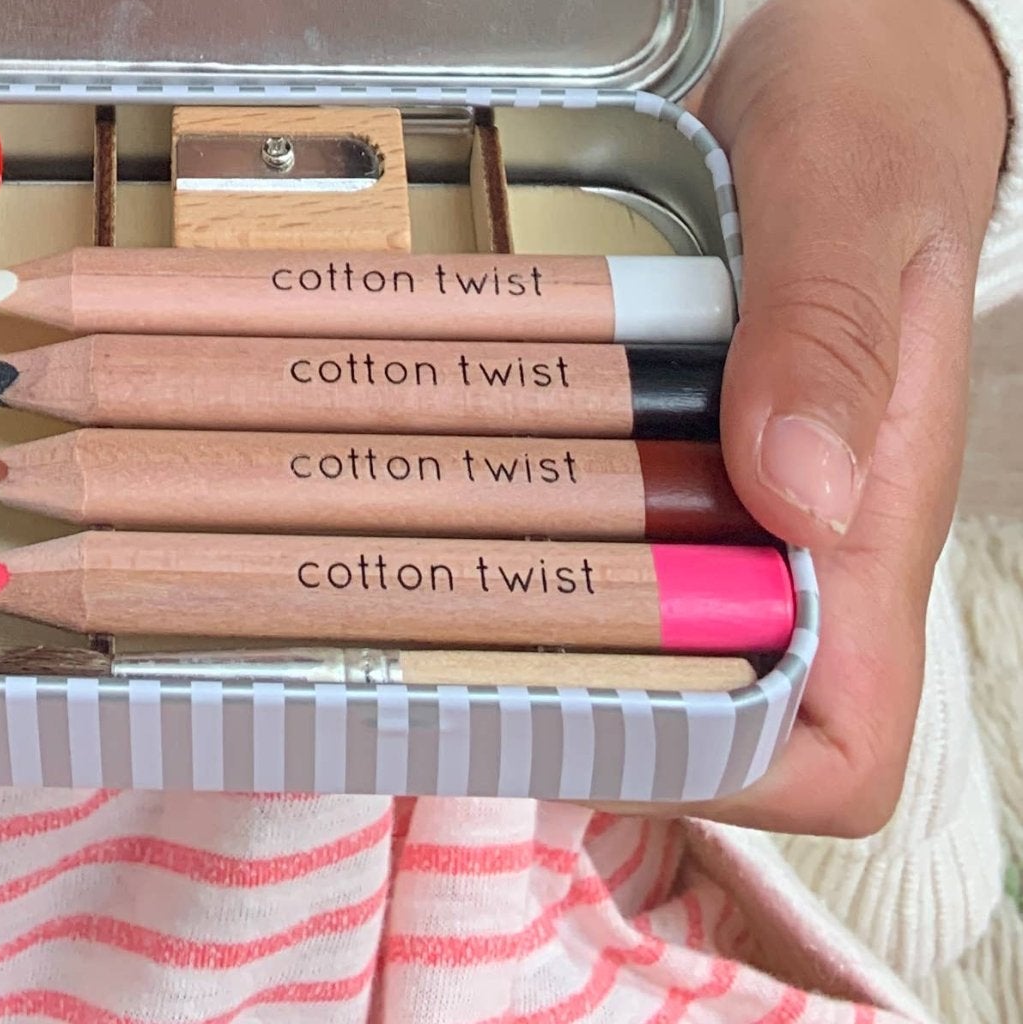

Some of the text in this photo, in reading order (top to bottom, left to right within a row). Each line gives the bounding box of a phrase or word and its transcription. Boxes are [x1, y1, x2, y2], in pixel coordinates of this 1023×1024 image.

[272, 262, 542, 296] cotton twist
[290, 353, 569, 388] cotton twist
[290, 447, 576, 484] cotton twist
[298, 554, 595, 595] cotton twist
